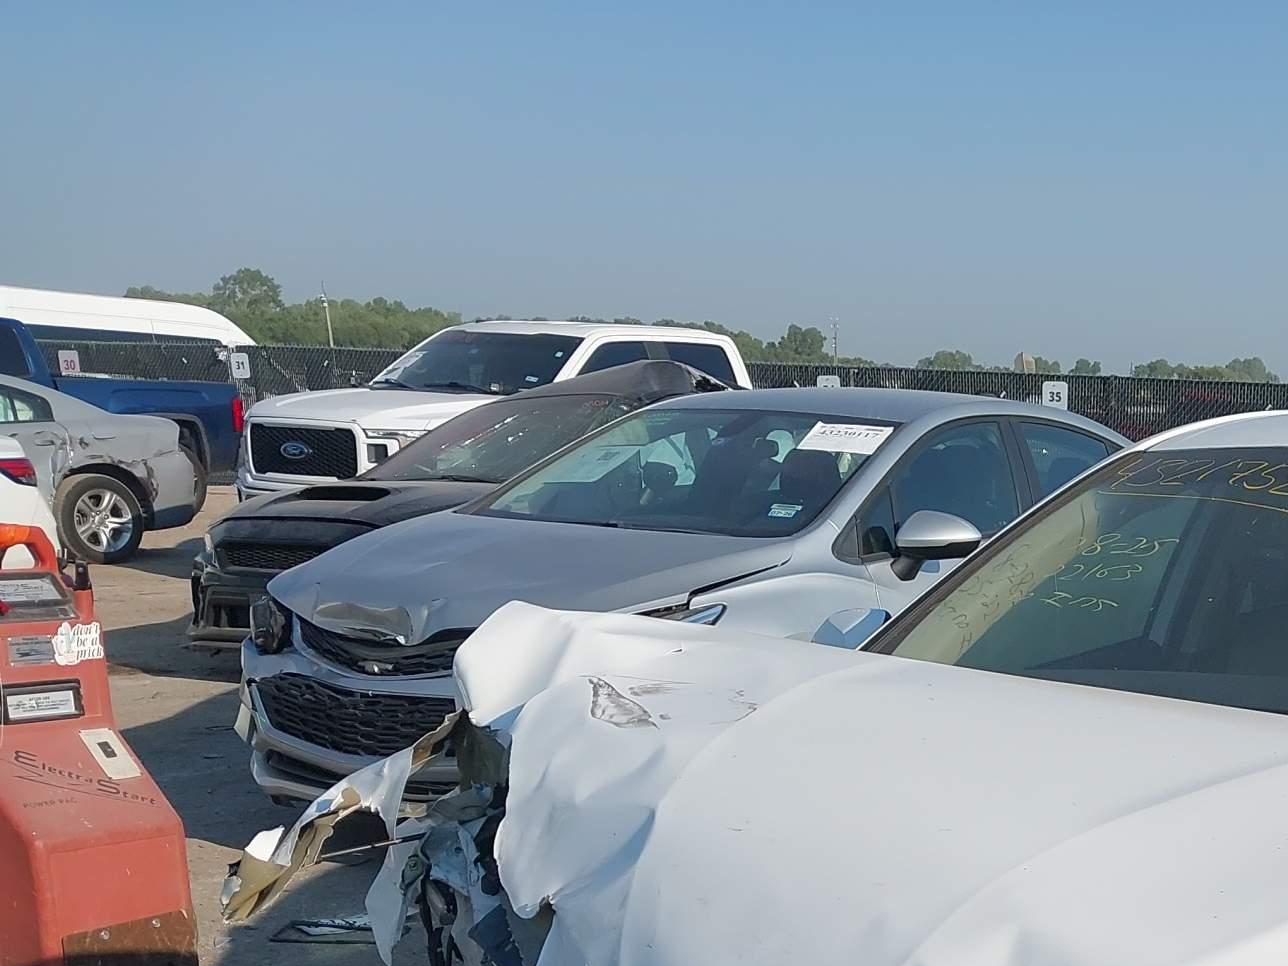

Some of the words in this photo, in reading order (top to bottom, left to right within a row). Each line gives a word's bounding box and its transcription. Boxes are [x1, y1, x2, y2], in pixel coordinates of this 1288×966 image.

[63, 359, 76, 371] 30
[235, 360, 246, 370] 31
[1048, 391, 1062, 402] 35
[72, 623, 99, 636] don't
[76, 636, 88, 647] be
[91, 637, 98, 646] a
[96, 778, 157, 805] Start
